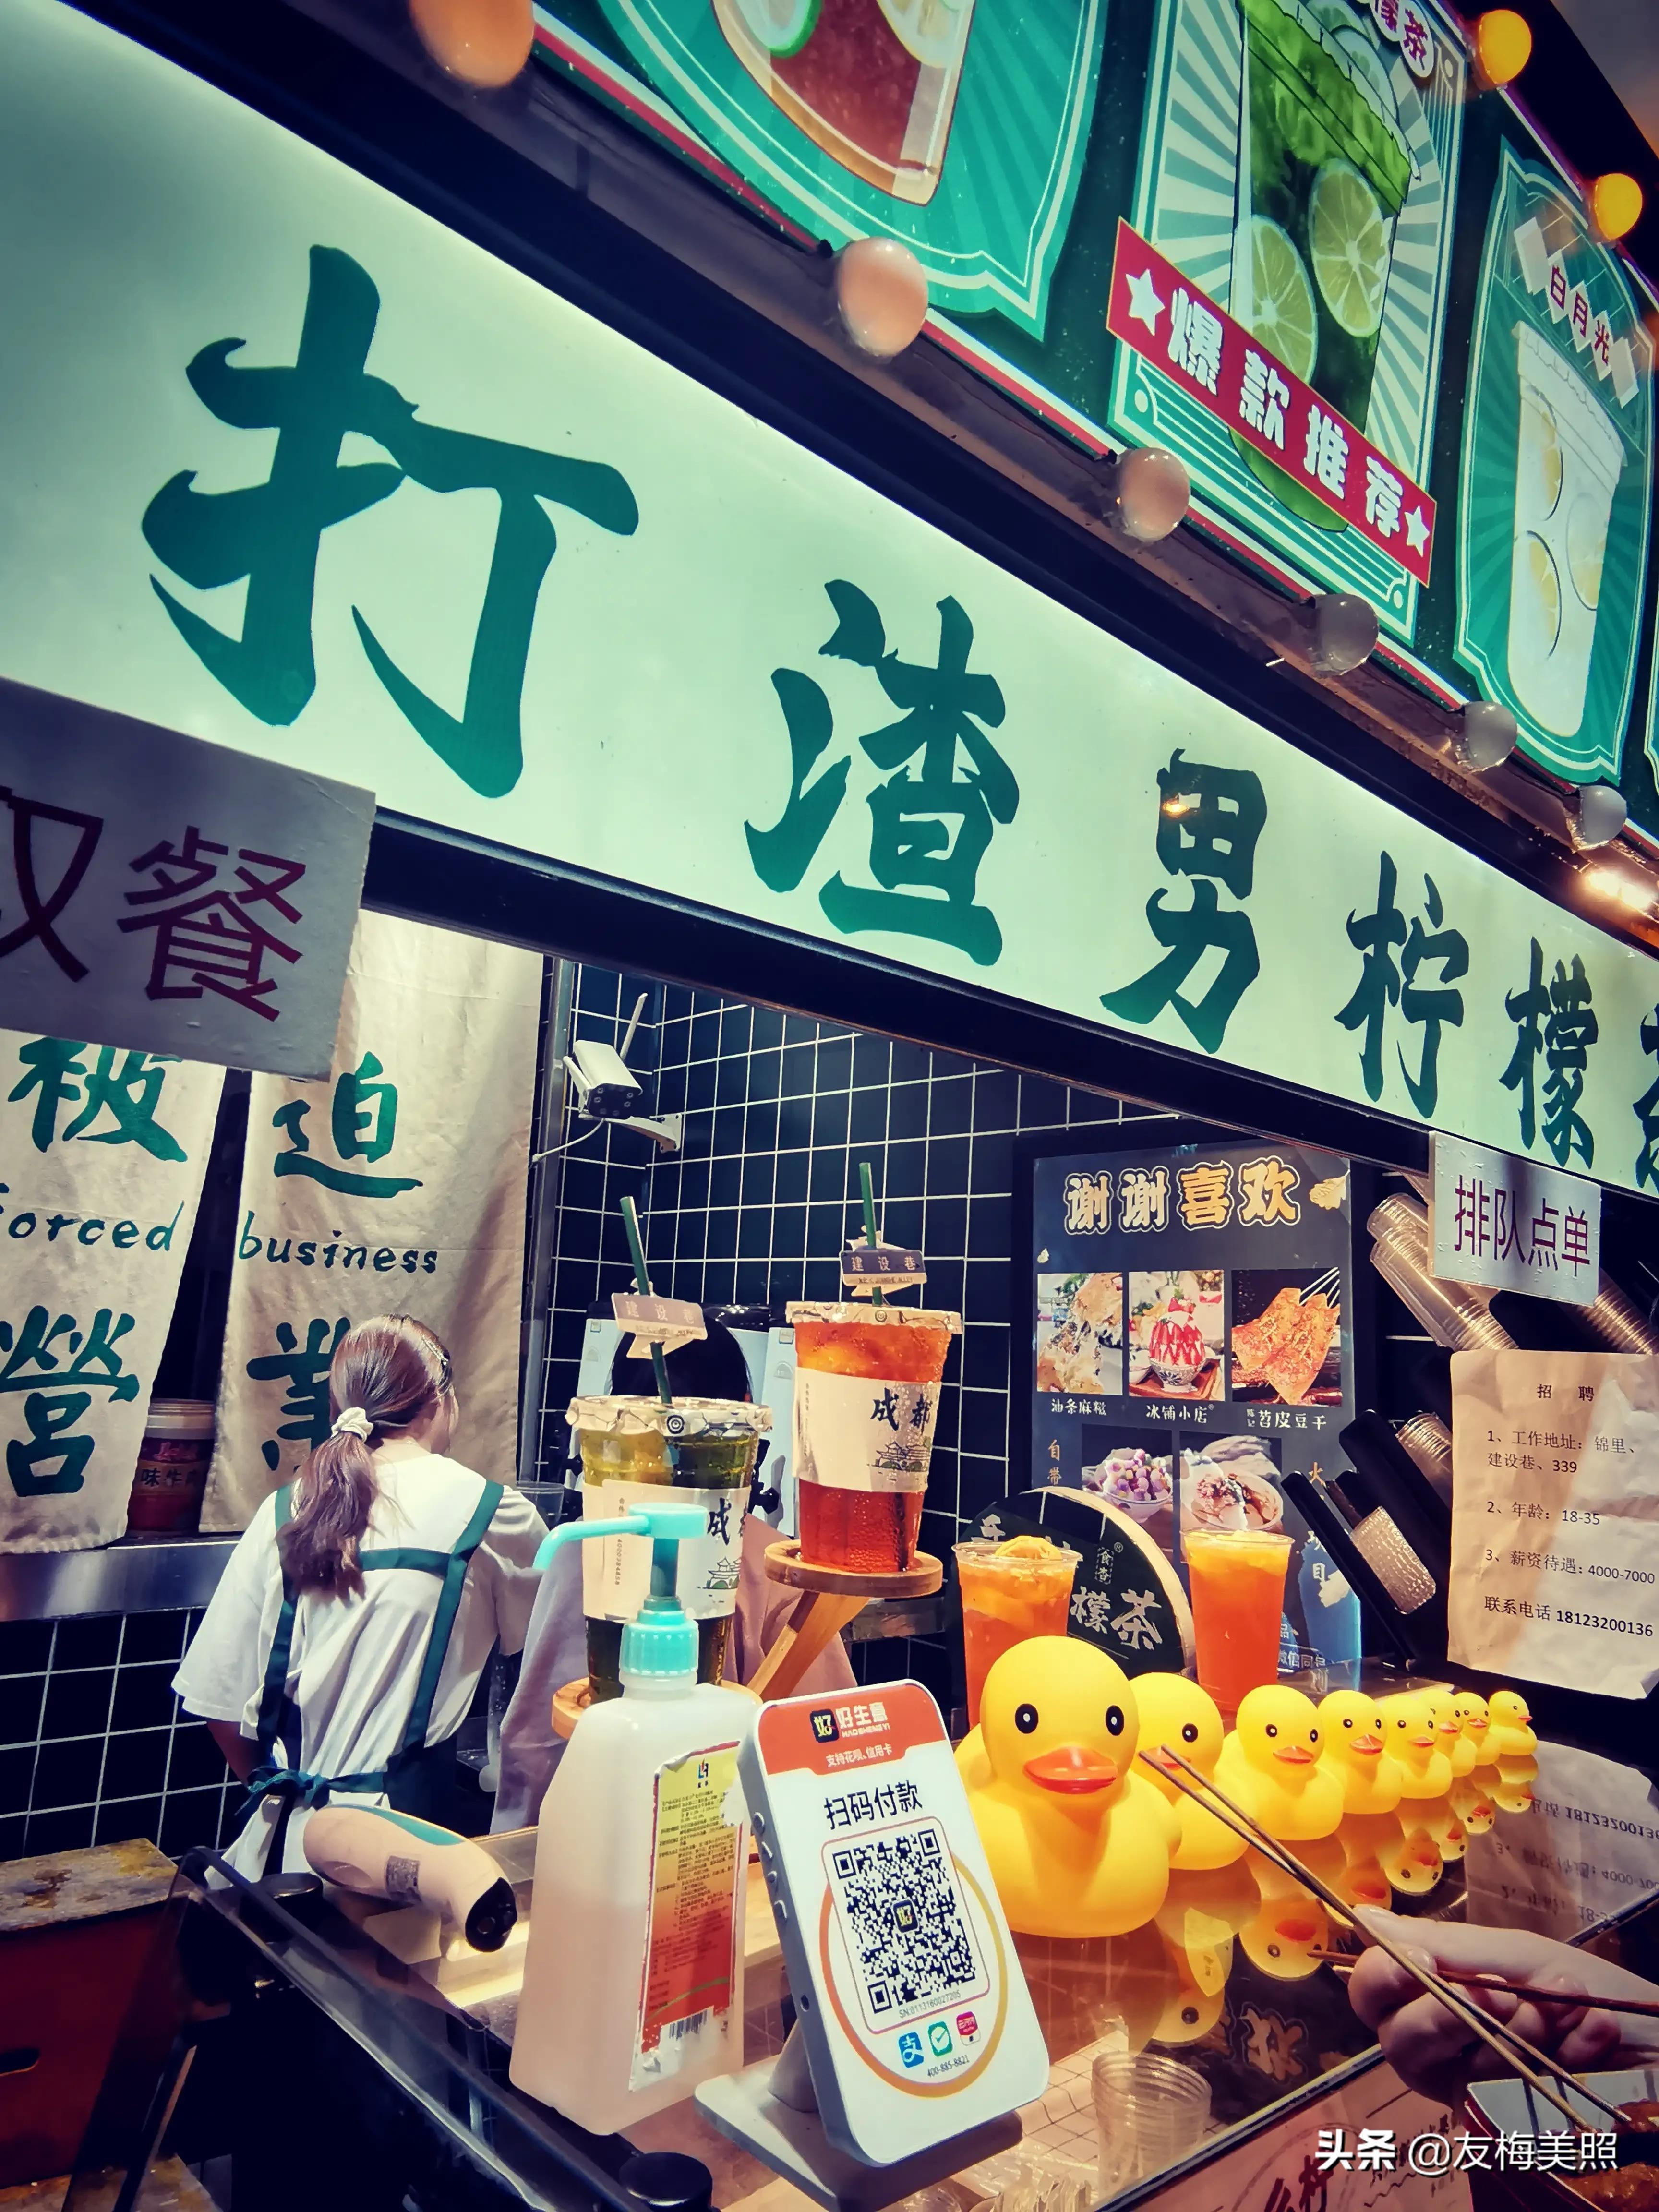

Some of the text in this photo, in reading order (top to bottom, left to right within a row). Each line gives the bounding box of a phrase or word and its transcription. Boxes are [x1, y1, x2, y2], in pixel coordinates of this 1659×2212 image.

[1550, 264, 1609, 366] 白月光
[1167, 287, 1403, 538] 爆款推荐
[1066, 1157, 1298, 1233] 谢谢喜欢
[0, 1183, 438, 1273] orced business
[1454, 1175, 1590, 1277] 排队点单
[851, 1256, 916, 1272] 建设巷
[870, 1387, 934, 1435] 成都
[1146, 1403, 1207, 1424] 冰铺小店
[1537, 1383, 1594, 1401] 招聘
[1487, 1453, 1577, 1474] 建设巷、339
[1484, 1595, 1653, 1637] 联系电话 18123200136
[835, 1702, 888, 1730] 好生意
[825, 1743, 893, 1768] 支持花呗、信用卡
[823, 1779, 923, 1830] 扫码付款
